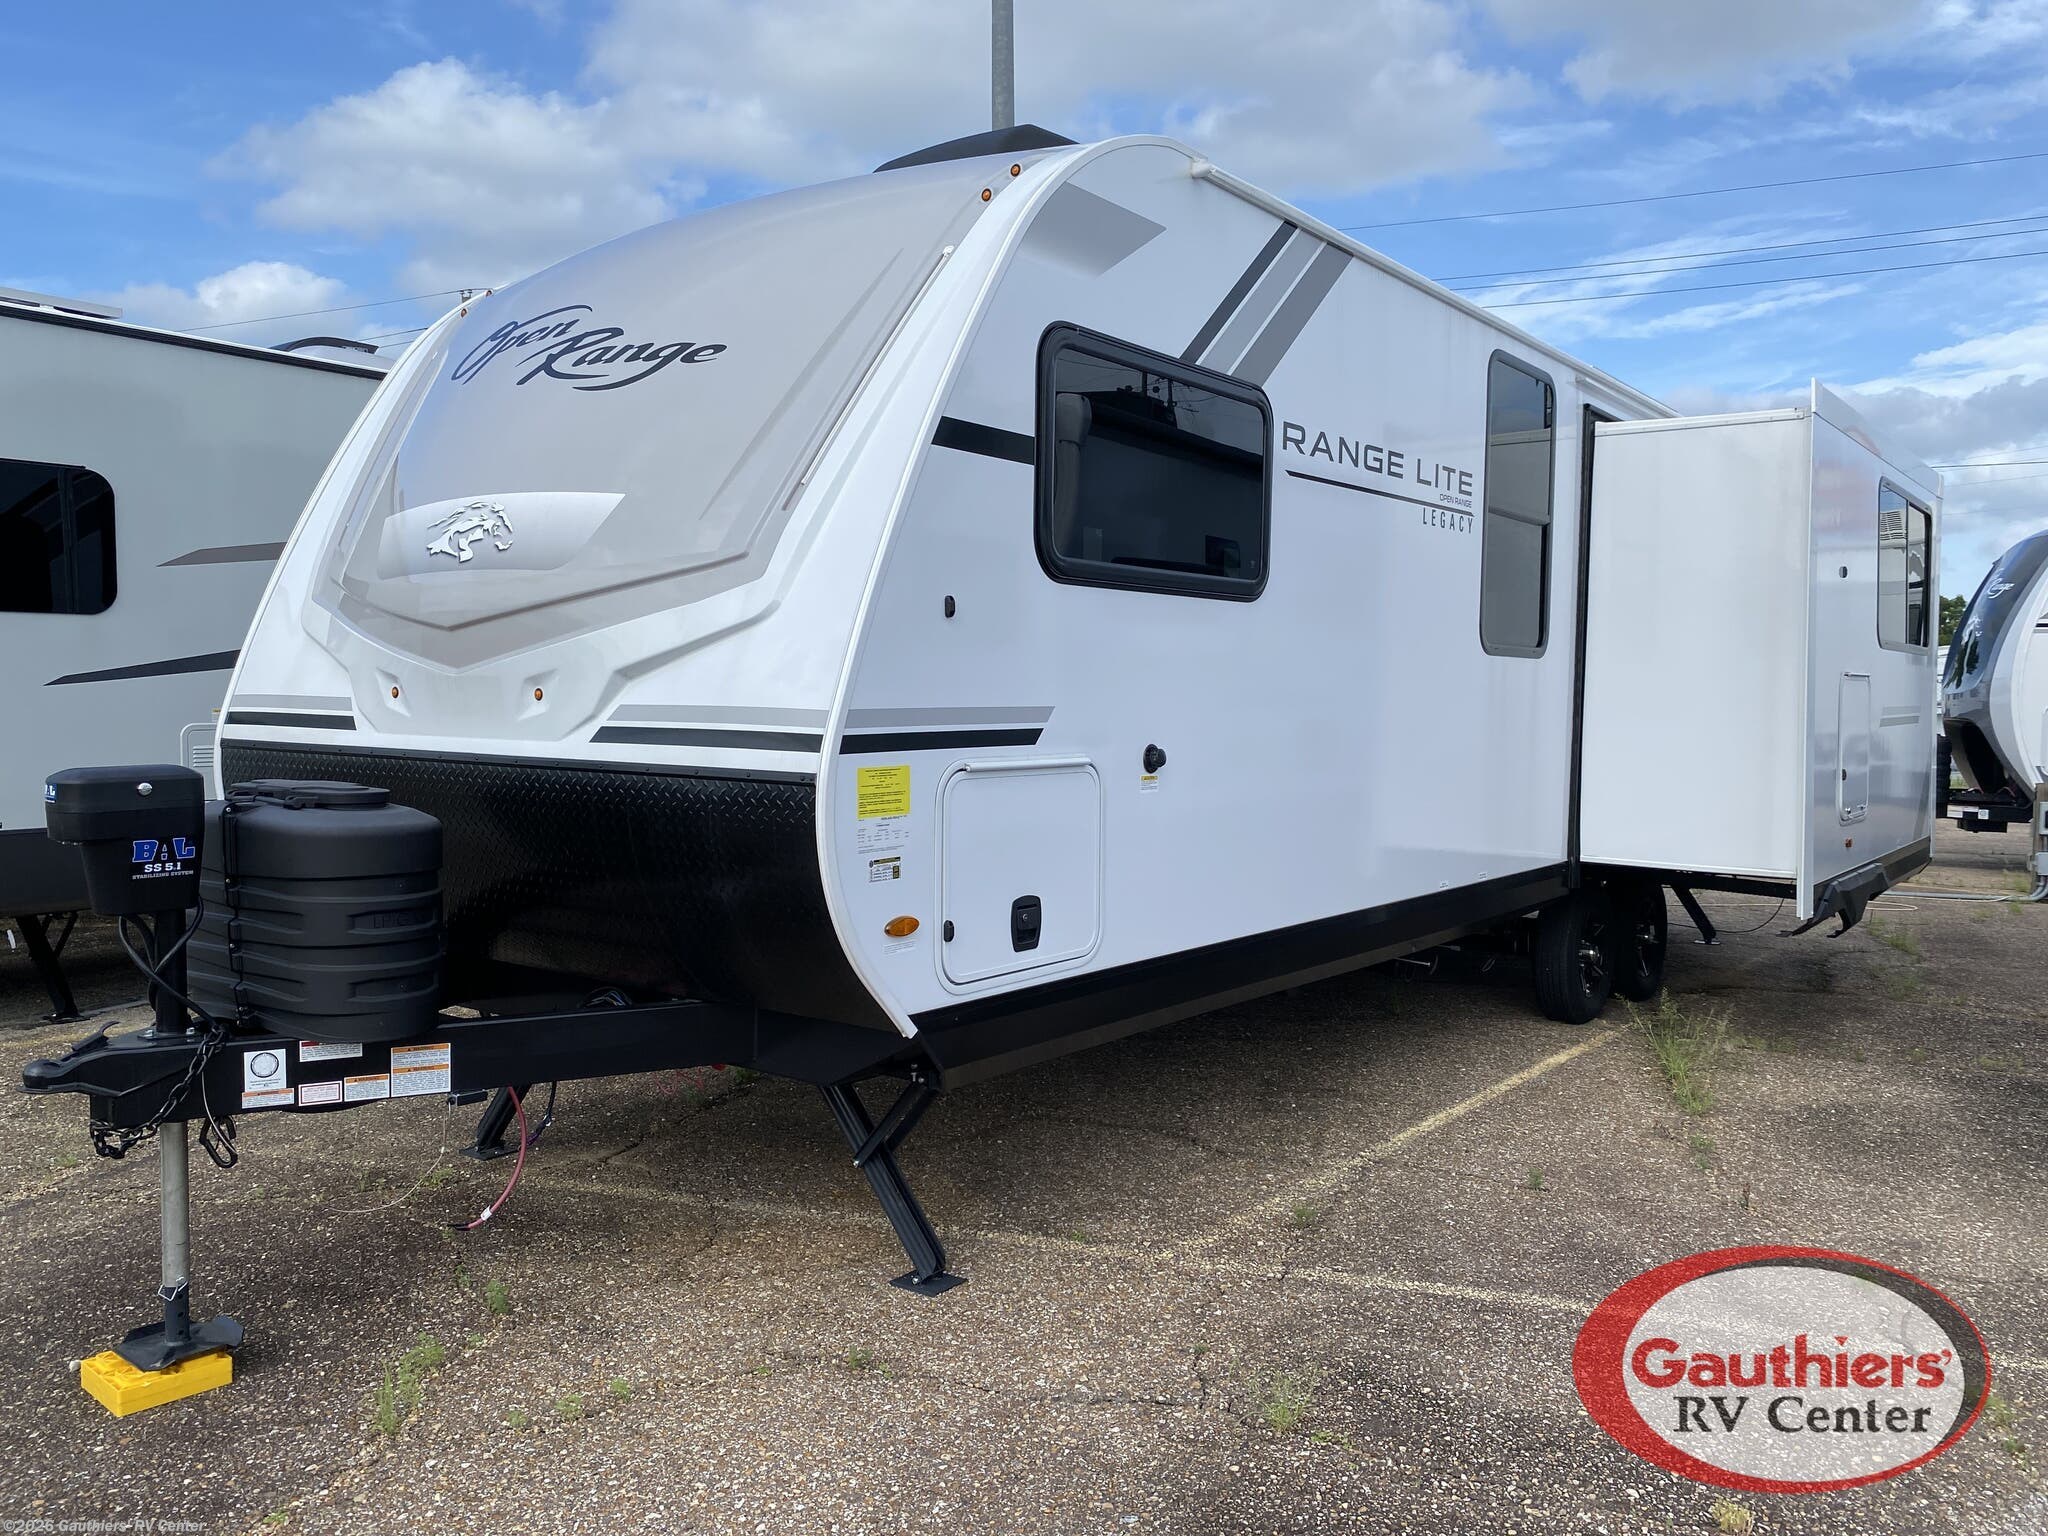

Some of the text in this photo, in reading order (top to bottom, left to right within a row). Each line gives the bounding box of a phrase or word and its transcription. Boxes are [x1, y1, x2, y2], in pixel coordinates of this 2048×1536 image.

[451, 304, 593, 385] Open
[515, 327, 728, 391] Range
[1282, 421, 1472, 496] RANGE LITE
[1422, 507, 1473, 534] LEGACY
[1440, 494, 1472, 508] OPEN RANGE
[144, 861, 182, 873] SS 5.1
